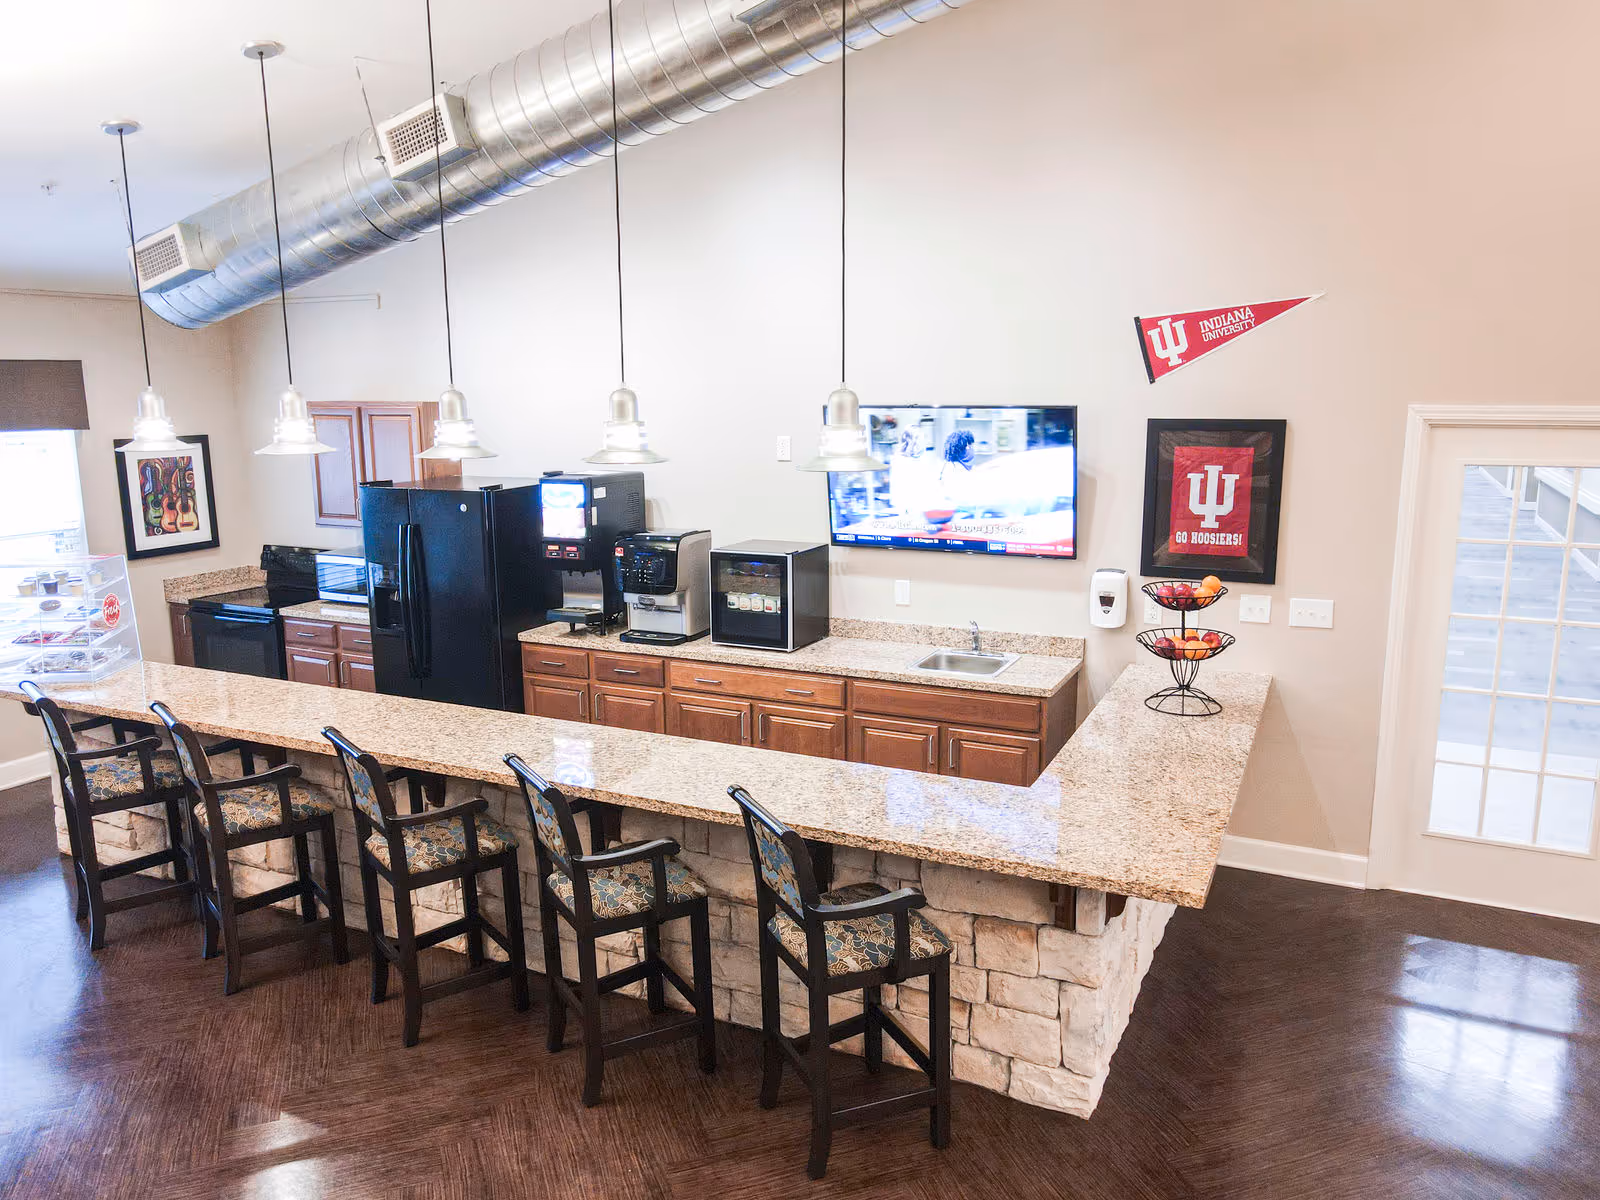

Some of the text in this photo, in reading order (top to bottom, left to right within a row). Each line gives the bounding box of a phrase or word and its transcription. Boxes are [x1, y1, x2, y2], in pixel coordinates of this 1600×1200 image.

[1199, 306, 1254, 333] INDIANA
[1202, 318, 1256, 342] UNIVERSITY
[1175, 531, 1243, 546] GO HOOSIERS!
